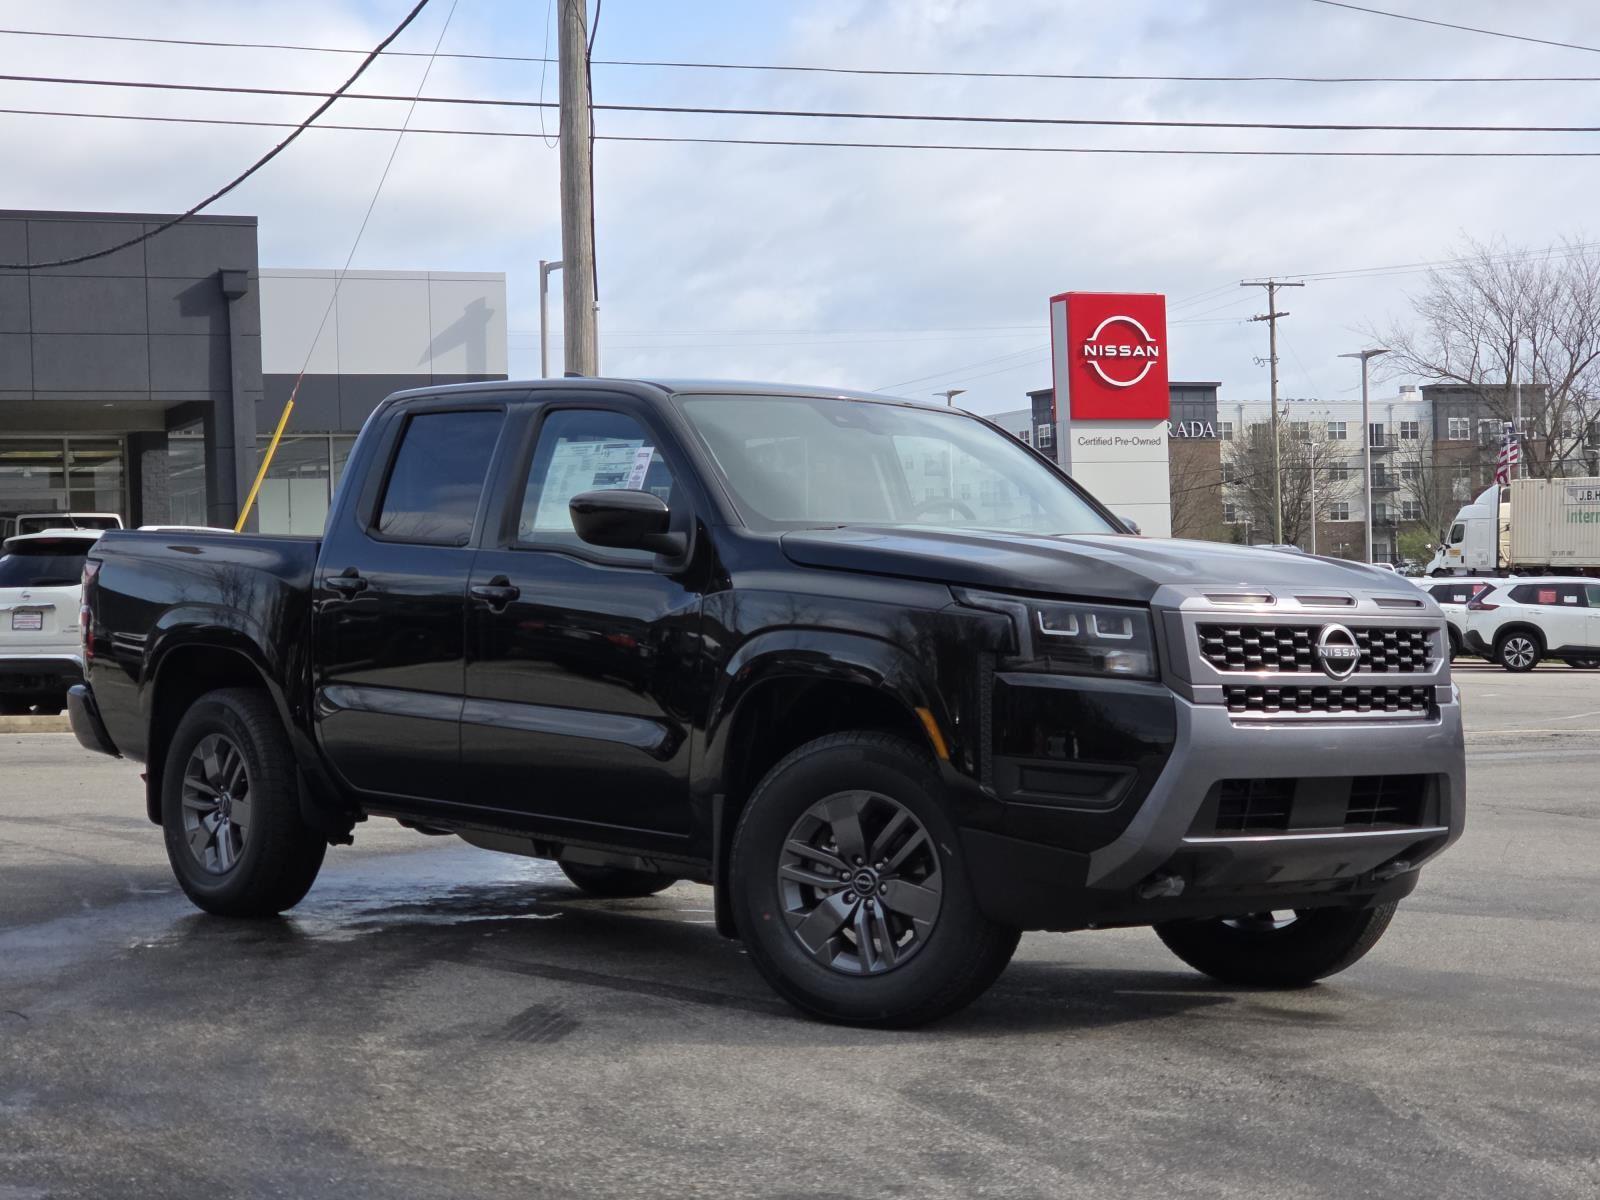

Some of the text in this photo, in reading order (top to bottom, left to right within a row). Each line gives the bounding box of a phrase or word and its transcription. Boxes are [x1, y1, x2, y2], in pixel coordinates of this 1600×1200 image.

[1084, 345, 1159, 357] NISSAN
[1078, 436, 1161, 446] Certified Pre-Owned
[1320, 648, 1360, 657] NISSAN
